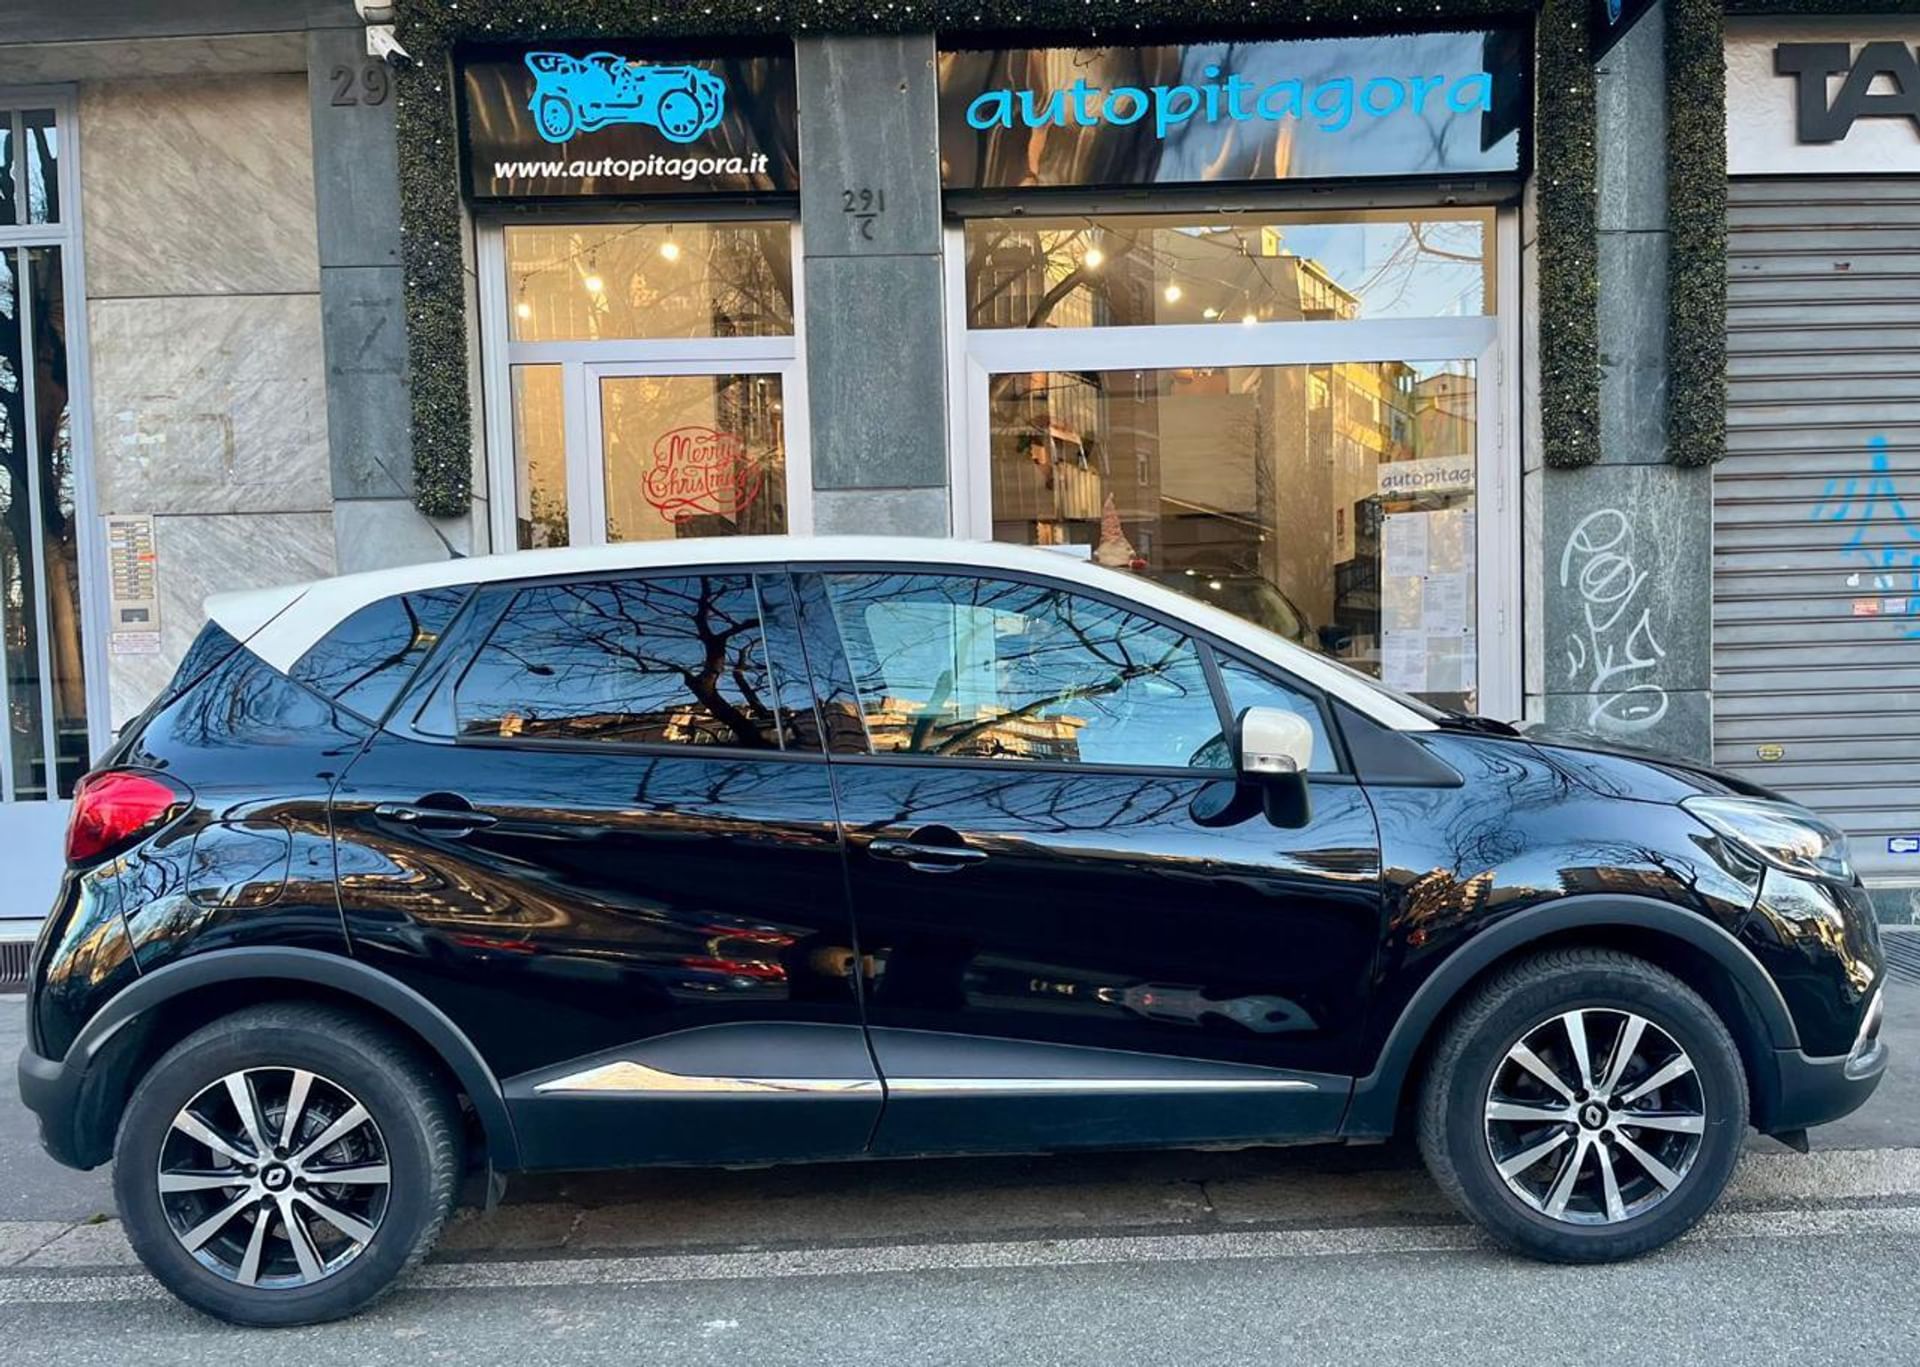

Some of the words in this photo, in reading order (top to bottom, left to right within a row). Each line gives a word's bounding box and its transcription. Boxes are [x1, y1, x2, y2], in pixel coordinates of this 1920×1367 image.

[966, 65, 1493, 138] autopitagora
[1773, 41, 1920, 145] TA
[494, 153, 769, 181] www.autopitagora.it
[842, 188, 885, 212] 291
